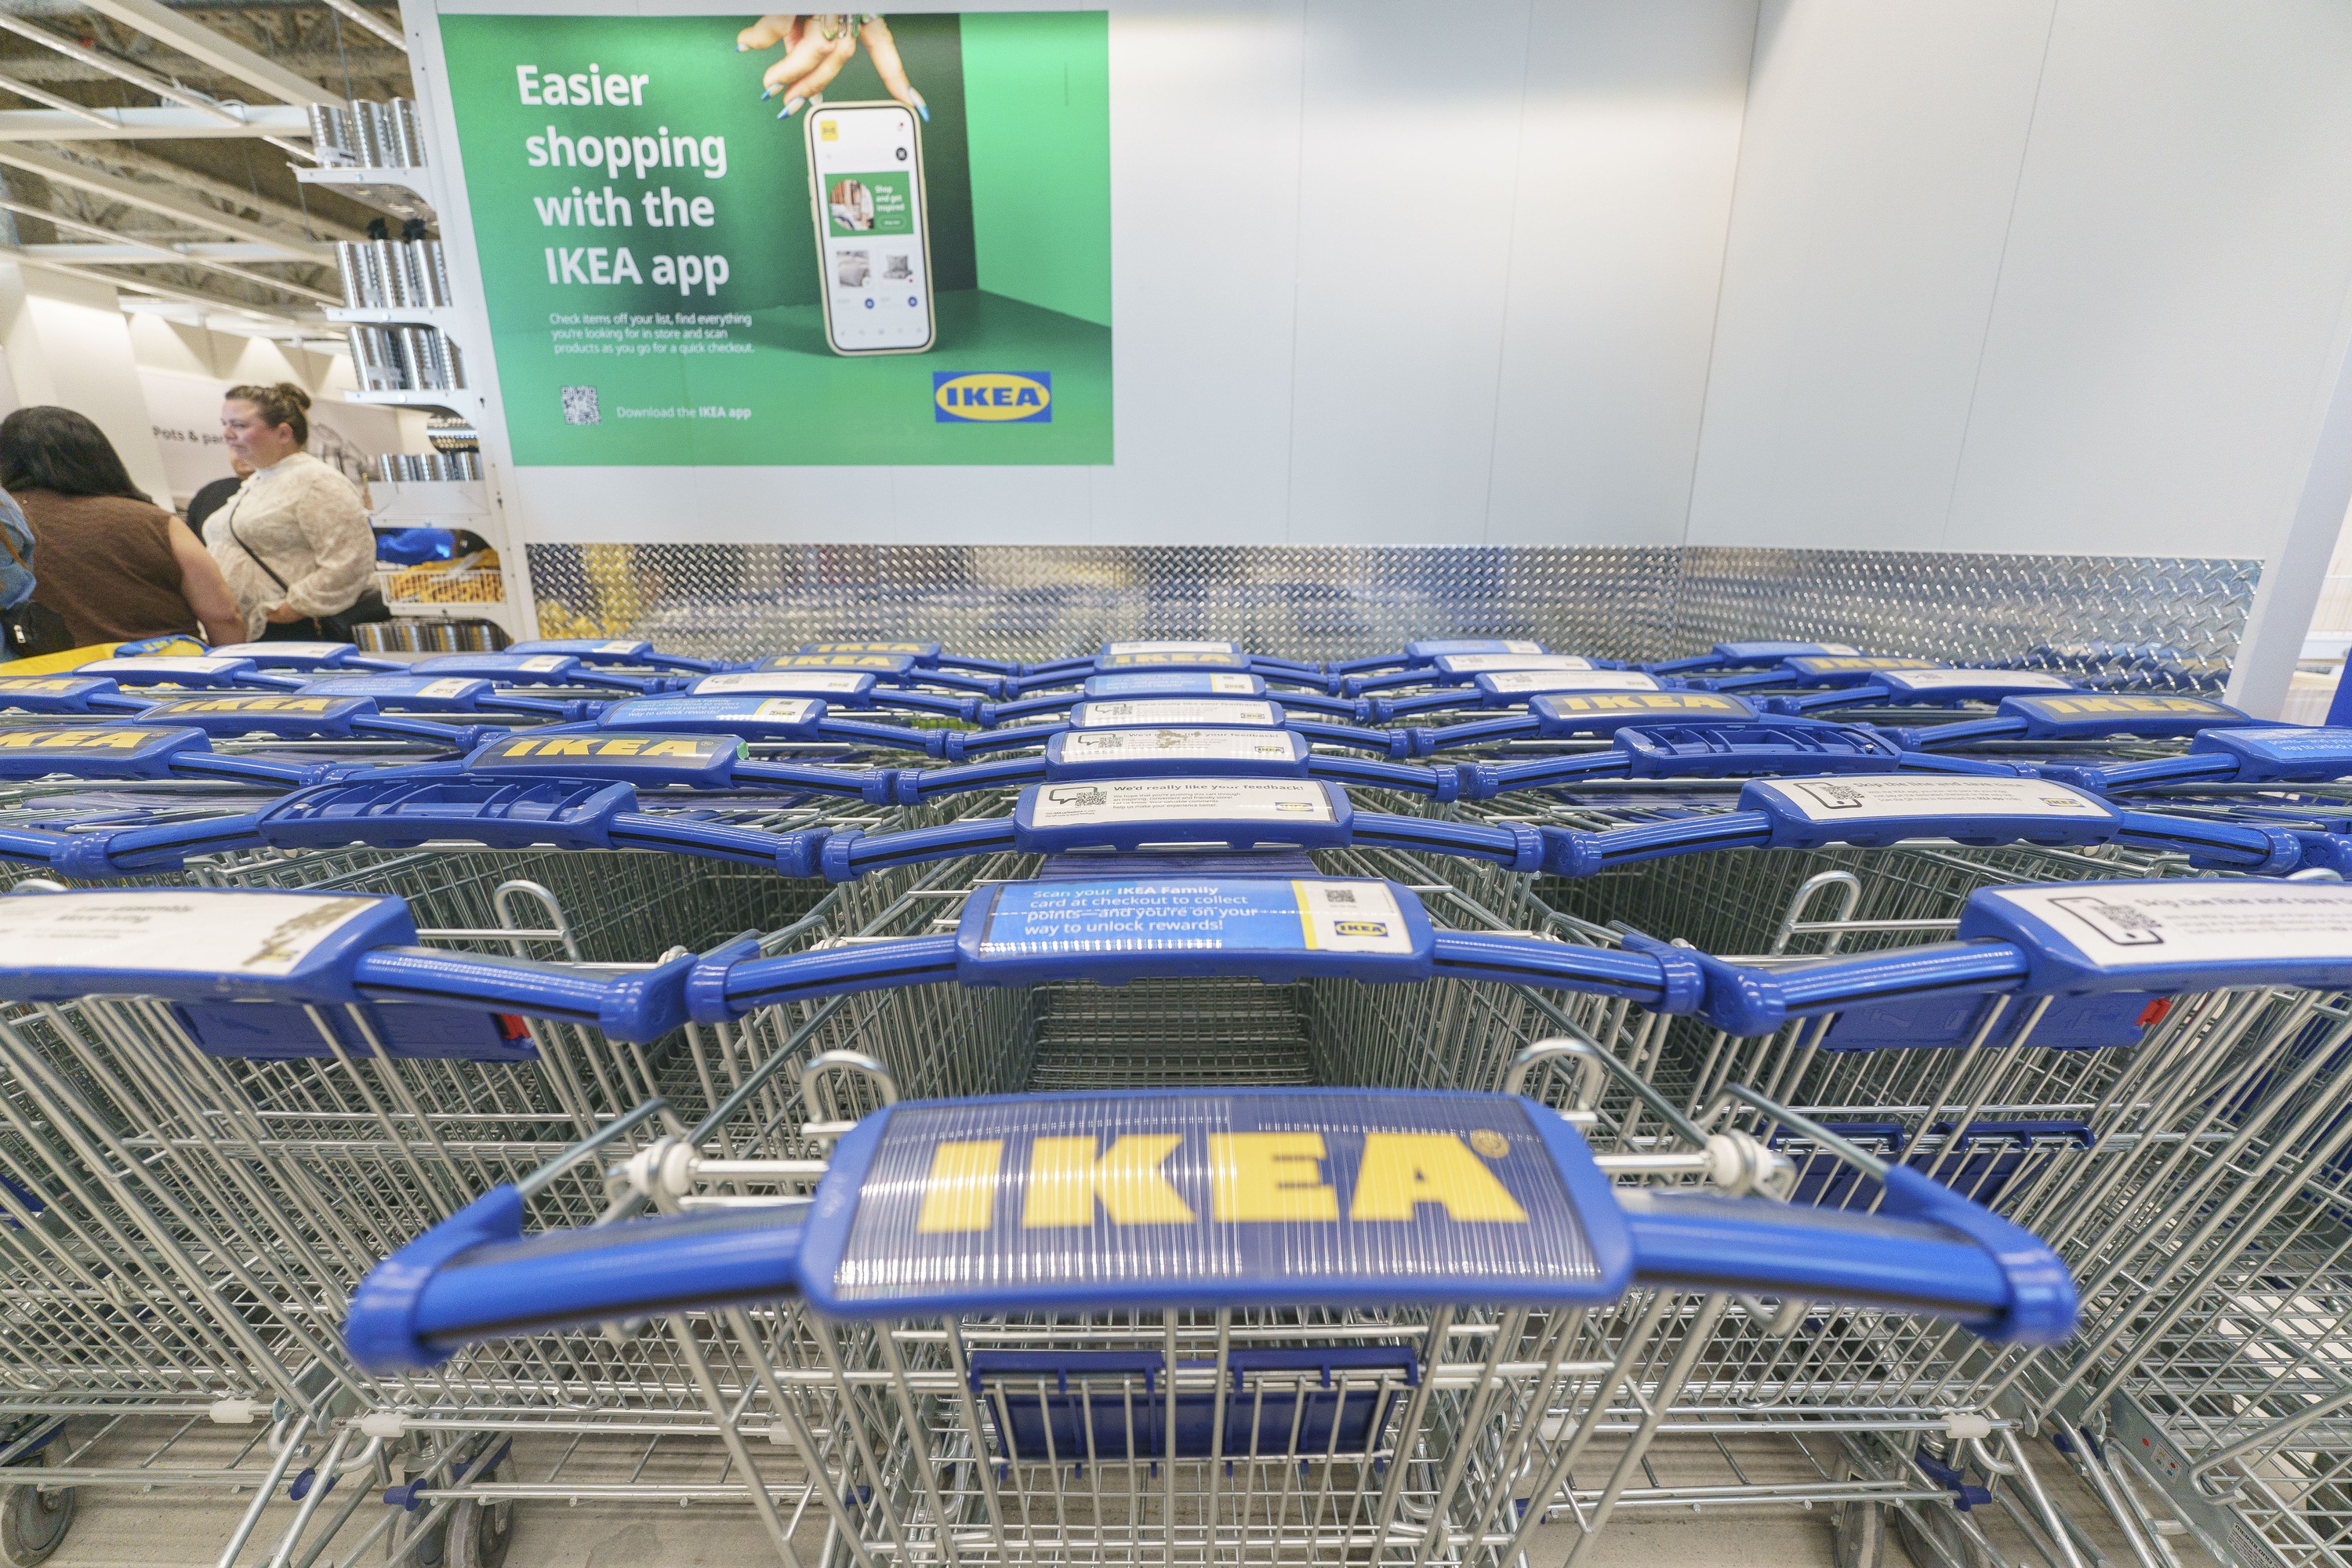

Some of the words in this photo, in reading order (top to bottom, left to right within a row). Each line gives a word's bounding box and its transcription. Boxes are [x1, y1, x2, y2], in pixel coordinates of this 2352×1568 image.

[516, 64, 648, 106] Easier
[526, 125, 728, 180] shopping
[533, 187, 632, 227] with
[641, 187, 714, 227] the
[545, 247, 643, 285] IKEA
[652, 253, 729, 296] app
[550, 313, 581, 325] Check
[583, 314, 612, 325] items
[612, 313, 627, 325] off
[629, 315, 653, 327] your
[655, 313, 674, 326] list,
[675, 313, 696, 325] find
[698, 314, 752, 327] everything
[551, 328, 583, 341] you're
[585, 328, 623, 342] looking
[625, 328, 640, 339] for
[642, 329, 652, 339] in
[655, 330, 681, 339] store
[682, 328, 703, 339] and
[704, 330, 728, 339] scan
[554, 343, 600, 355] products
[616, 344, 635, 356] you
[637, 344, 651, 356] go
[652, 343, 667, 353] for
[679, 343, 704, 356] quick
[946, 387, 1041, 406] IKEA
[616, 407, 674, 419] Download
[677, 407, 696, 418] the
[699, 407, 726, 418] IKEA
[728, 408, 751, 421] app
[152, 425, 184, 441] Pots
[188, 430, 199, 442] &
[818, 643, 920, 652] IKEA
[775, 655, 891, 666] IKEA
[1116, 653, 1231, 664] IKEA
[1811, 659, 1936, 669] IKEA
[0, 679, 74, 690] EA
[169, 698, 331, 713] IKEA
[1563, 695, 1730, 710] IKEA
[2042, 699, 2218, 713] IKEA
[0, 731, 152, 747] KEA
[502, 739, 697, 757] IKEA
[1074, 889, 1112, 898] your
[1030, 898, 1065, 908] card
[1091, 897, 1167, 906] checkout
[1135, 908, 1187, 919] you're
[1219, 908, 1256, 919] your
[1024, 924, 1059, 936] way
[1064, 923, 1082, 932] to
[1087, 920, 1144, 931] unlock
[1149, 920, 1223, 931] rewards!
[916, 1131, 1528, 1233] IKEA
